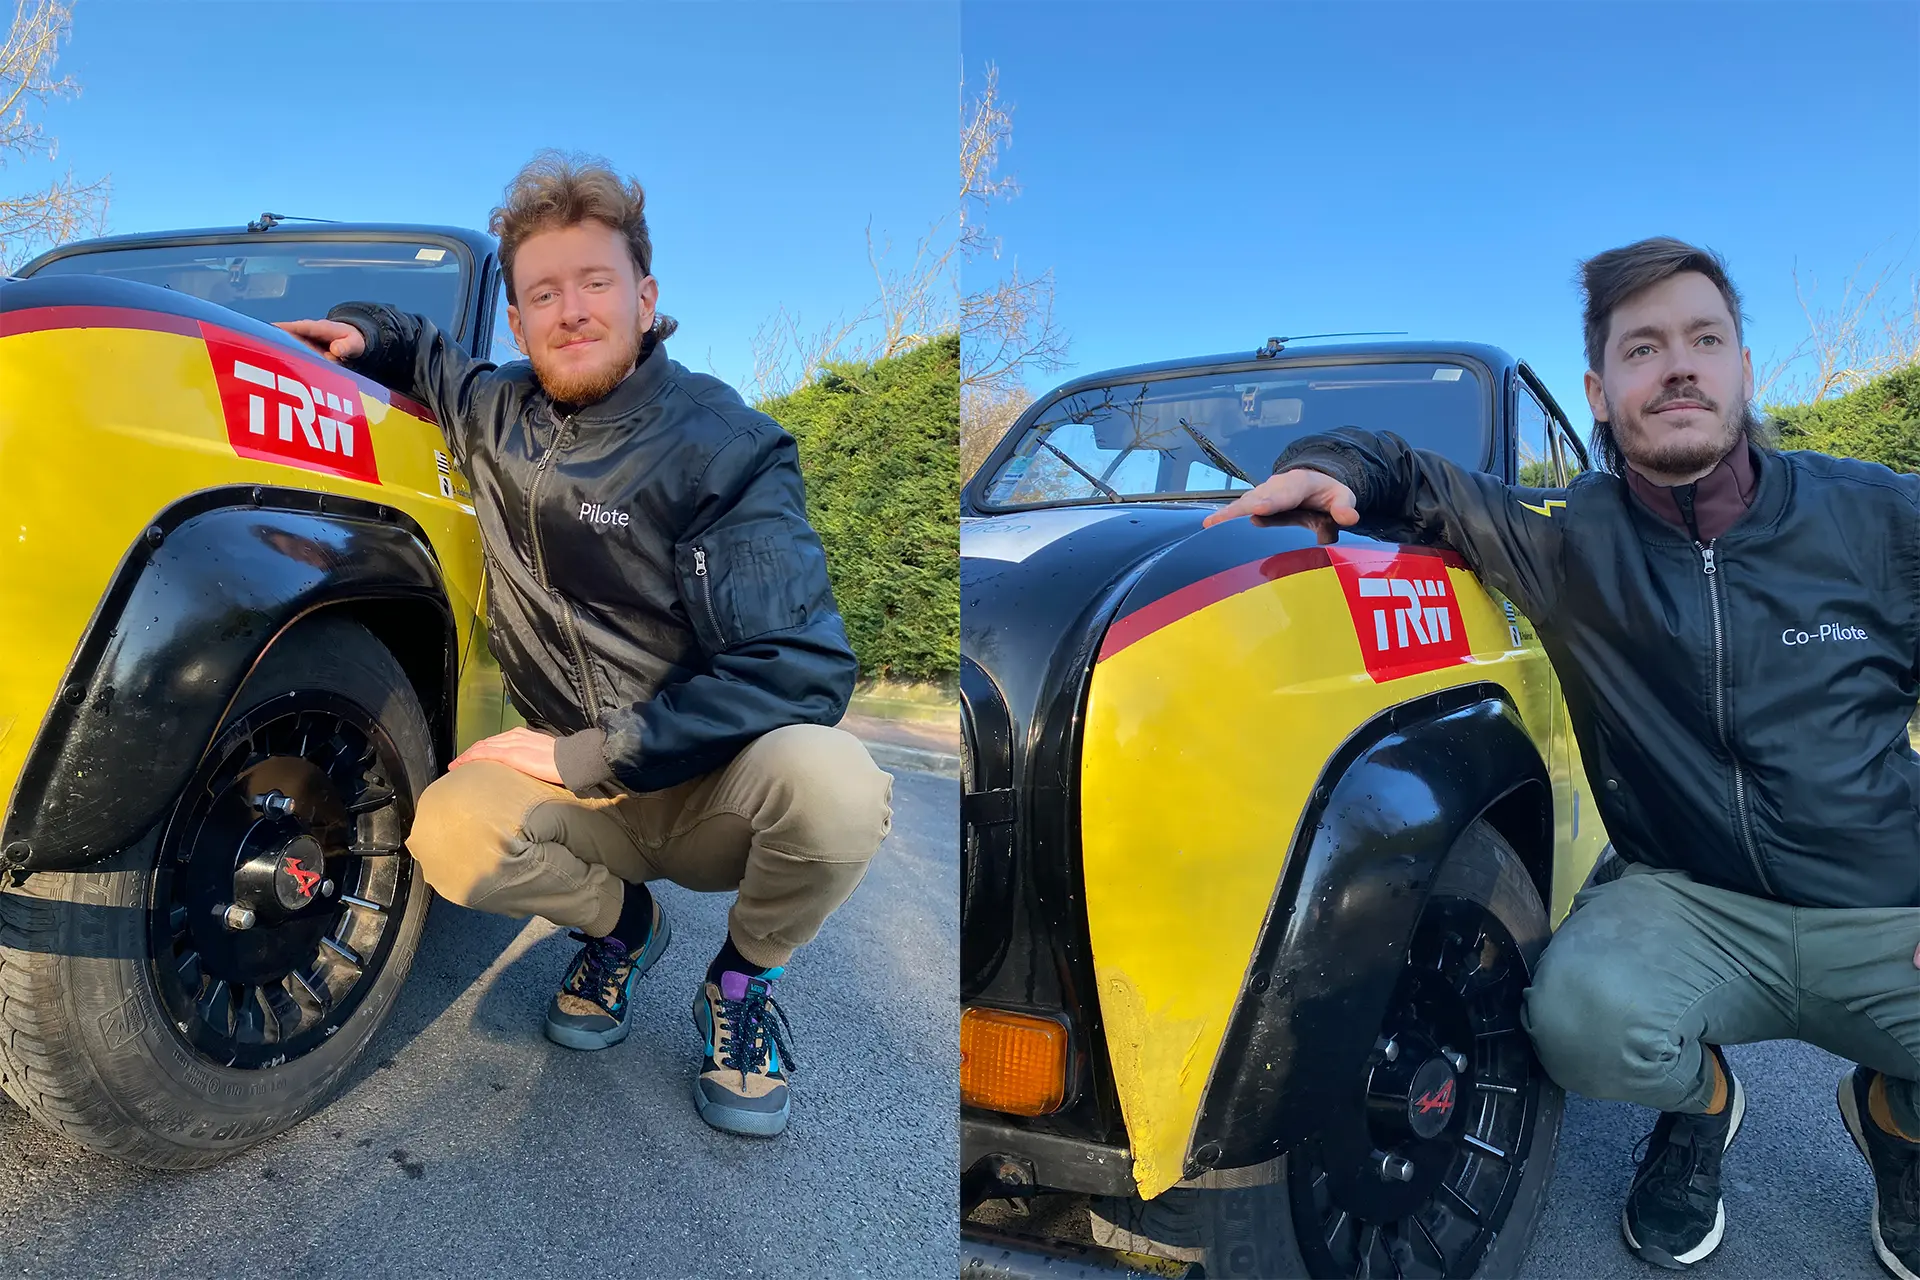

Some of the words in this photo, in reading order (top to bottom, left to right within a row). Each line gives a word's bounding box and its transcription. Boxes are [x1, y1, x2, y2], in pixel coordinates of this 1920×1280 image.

[234, 359, 354, 458] TRW
[579, 502, 630, 528] Pilote
[1358, 577, 1452, 652] TRW
[1781, 622, 1869, 646] Co-Pilote
